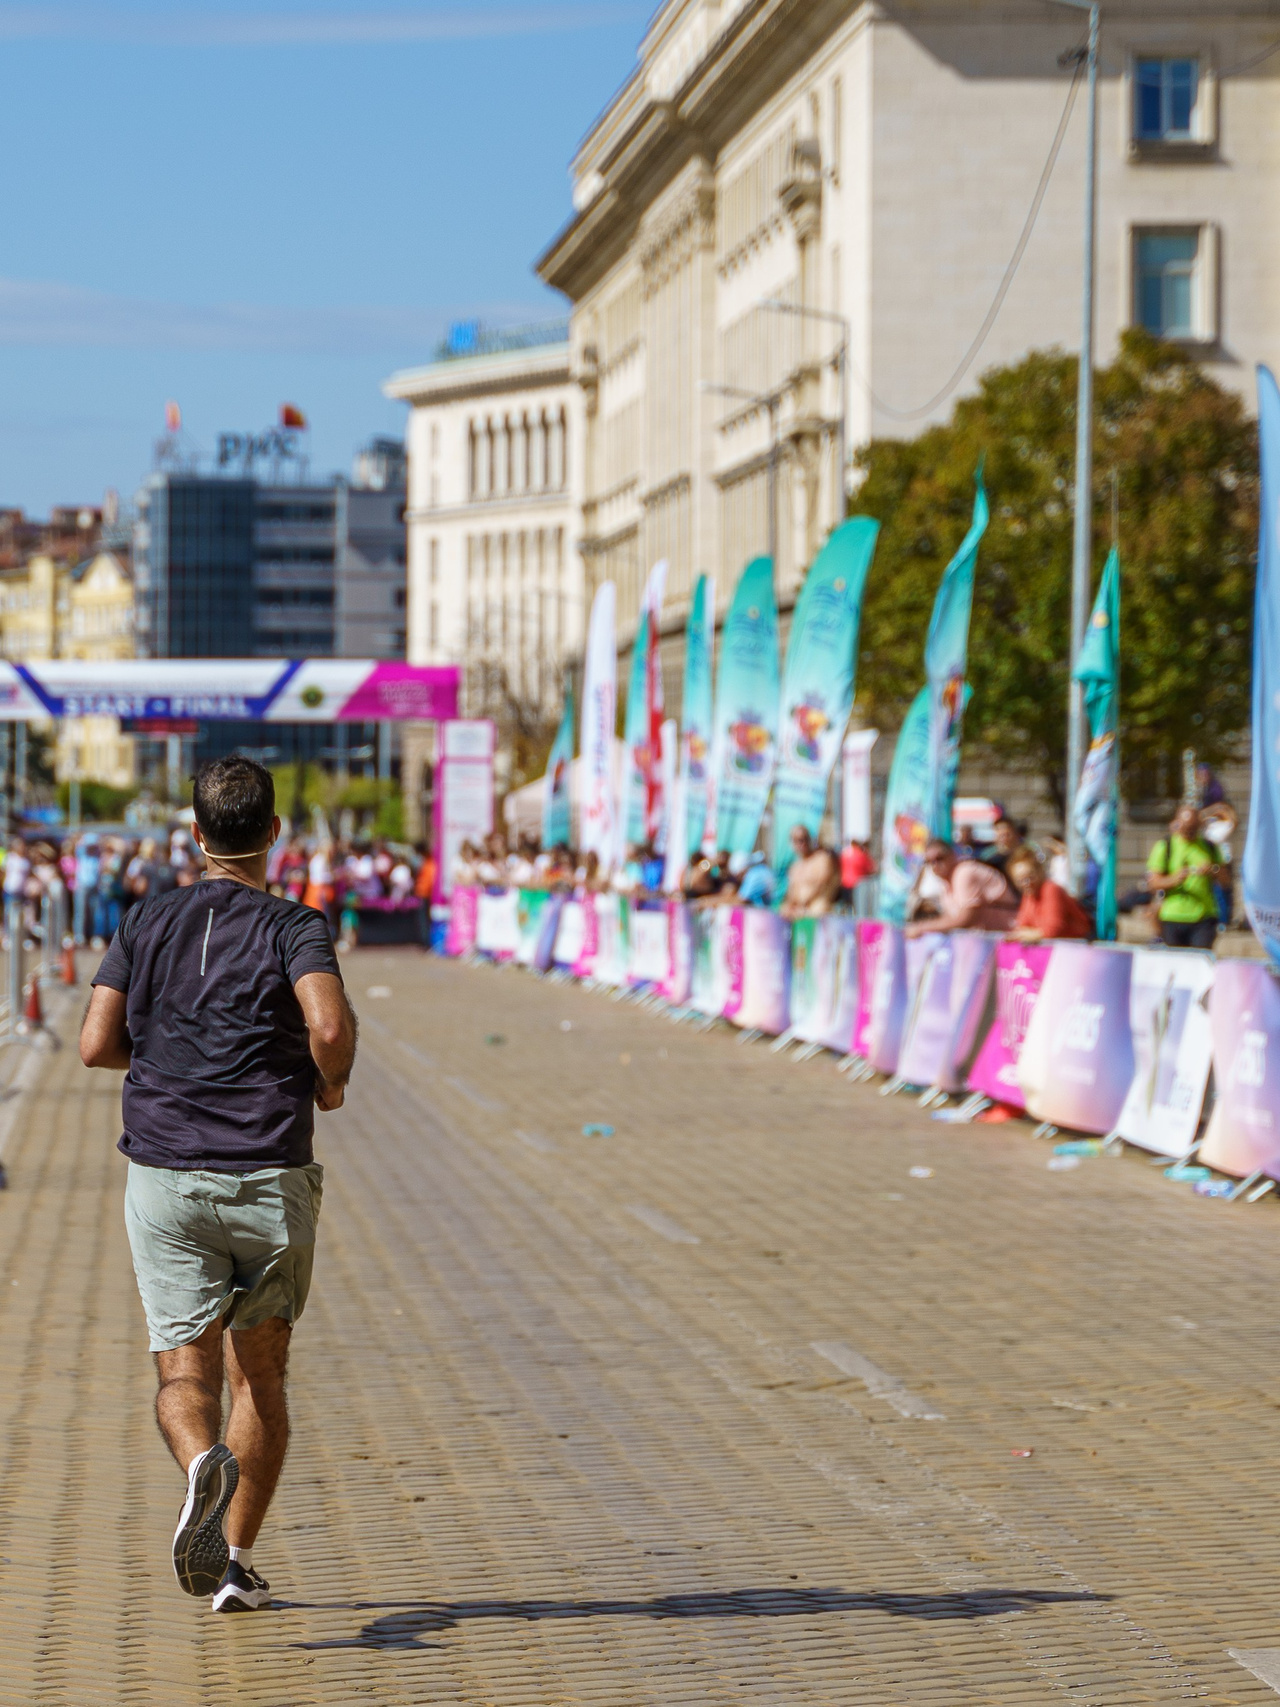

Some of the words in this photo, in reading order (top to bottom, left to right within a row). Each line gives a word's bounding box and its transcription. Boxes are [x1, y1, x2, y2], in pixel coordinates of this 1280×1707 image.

[218, 428, 298, 468] pwc
[63, 695, 145, 717] START
[172, 695, 252, 717] FINAL
